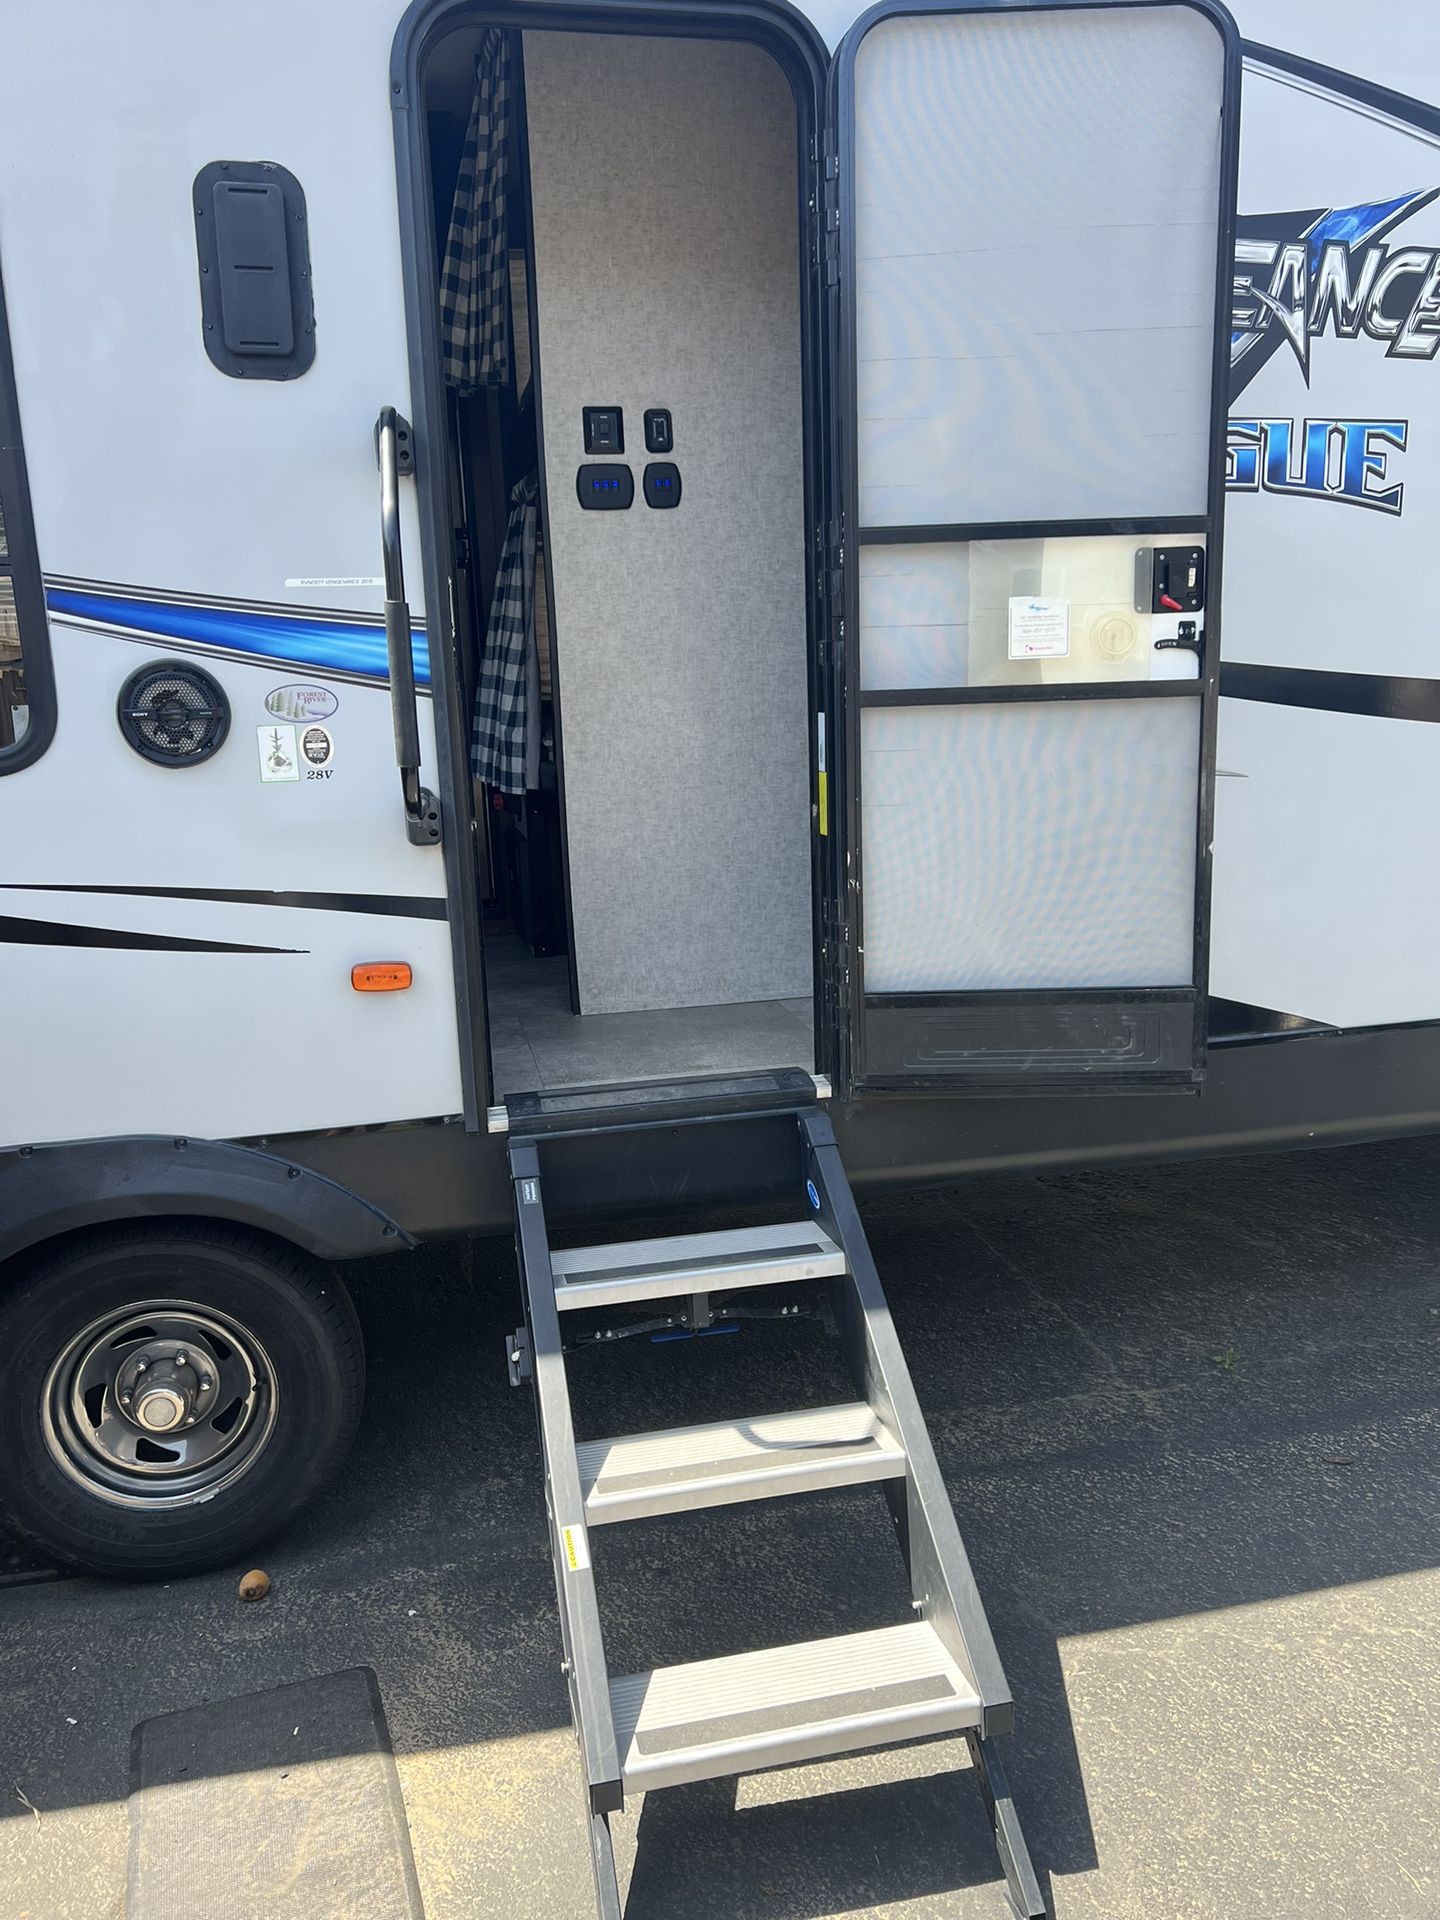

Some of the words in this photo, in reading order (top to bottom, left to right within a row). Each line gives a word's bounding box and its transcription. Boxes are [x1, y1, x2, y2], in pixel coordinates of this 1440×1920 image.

[296, 691, 327, 700] FOREST
[303, 697, 327, 705] RIVER
[306, 770, 334, 780] 28V
[564, 1529, 576, 1562] CAUTION
